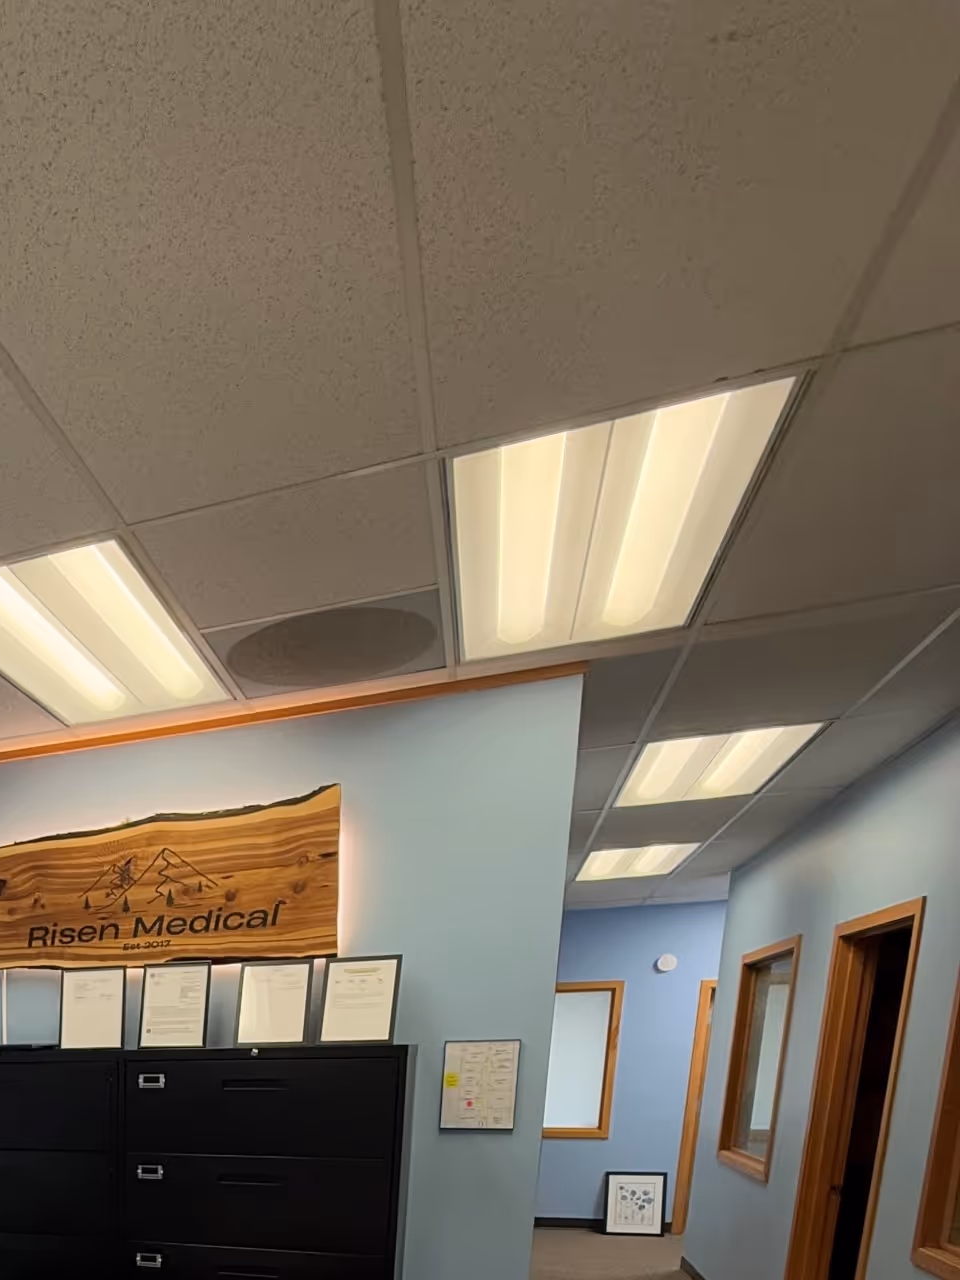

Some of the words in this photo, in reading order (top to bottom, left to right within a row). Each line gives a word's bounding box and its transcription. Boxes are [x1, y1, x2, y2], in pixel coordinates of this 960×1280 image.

[27, 922, 120, 948] Risen
[133, 902, 281, 938] Medical
[142, 939, 171, 950] 2017
